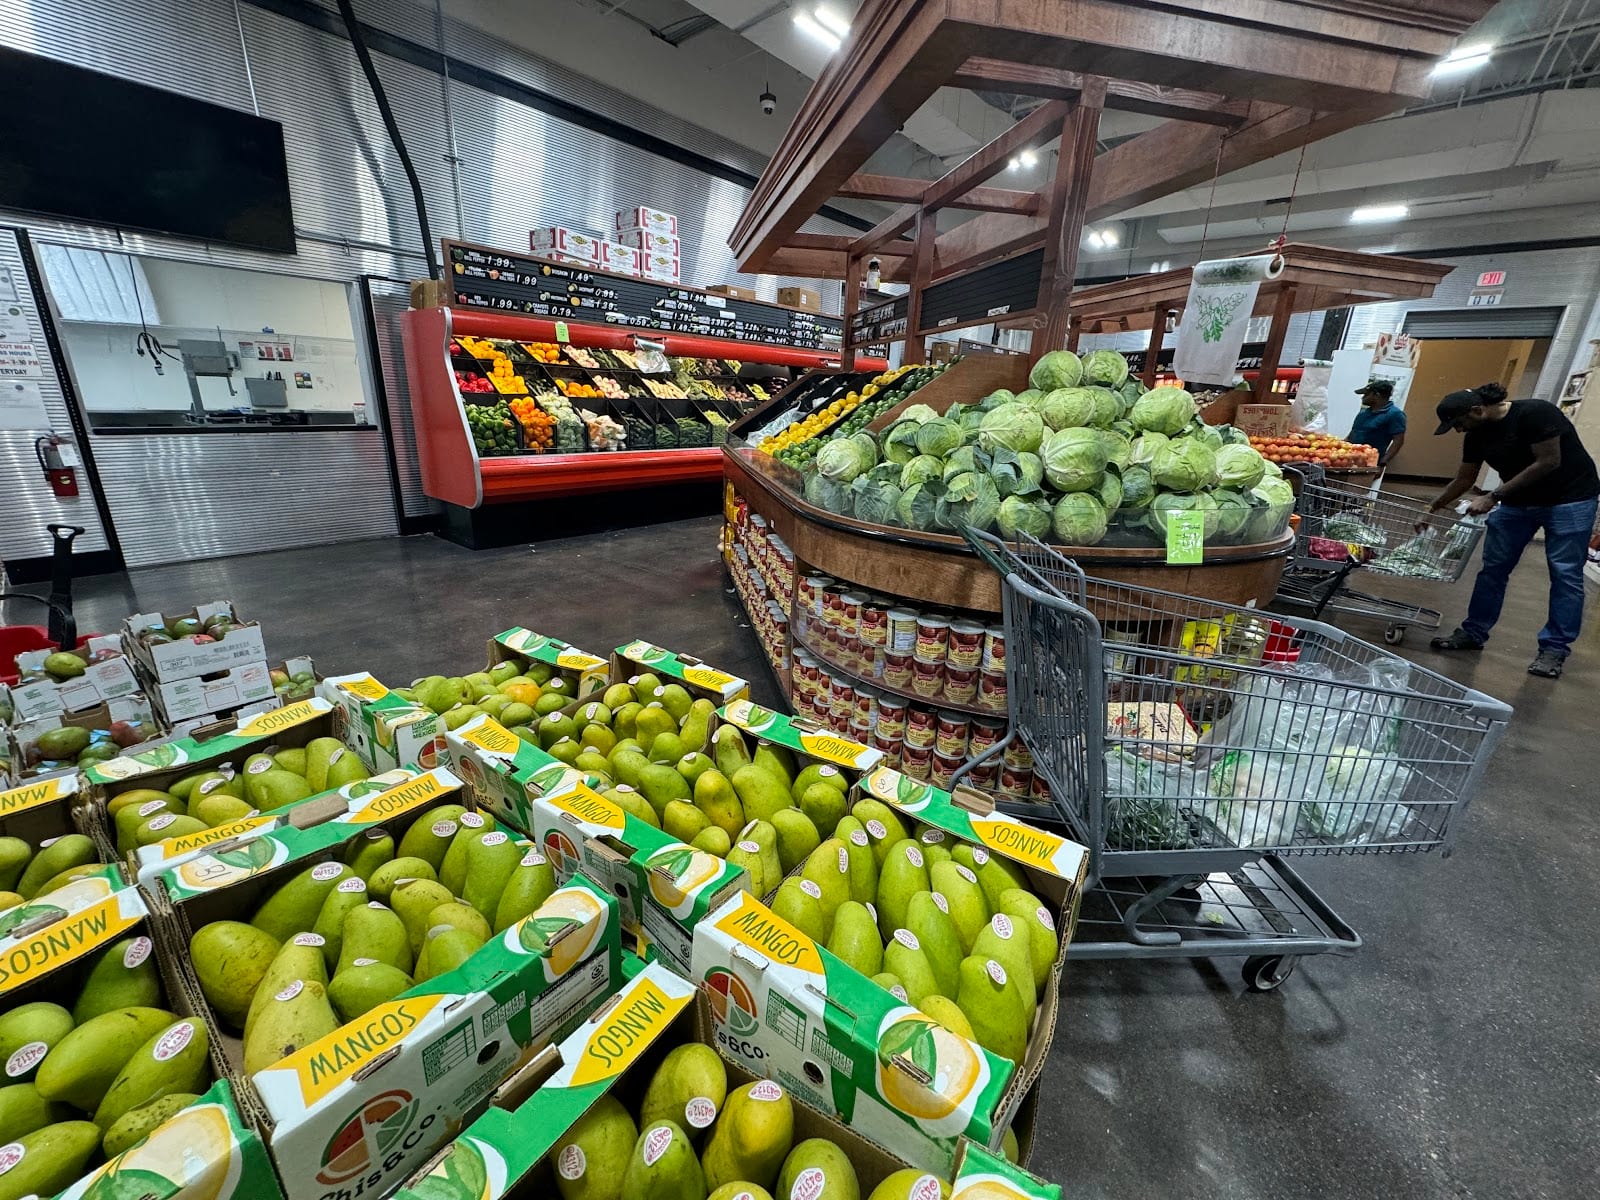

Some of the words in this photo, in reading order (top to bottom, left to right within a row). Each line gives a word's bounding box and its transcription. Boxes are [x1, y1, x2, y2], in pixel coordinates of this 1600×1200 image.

[516, 274, 537, 286] 1.99
[1481, 272, 1503, 284] EXIT
[491, 297, 512, 310] 1.99
[259, 704, 312, 732] MANGOS
[472, 726, 515, 751] MANGOS
[811, 737, 861, 762] MANGOS
[371, 780, 436, 816] MANGOS
[562, 793, 619, 824] MANGOS
[175, 820, 257, 852] MANGOS
[990, 825, 1057, 861] MANGOS
[0, 909, 108, 985] MANGOS
[733, 911, 811, 965] MANGOS
[590, 989, 667, 1070] MANGOS
[309, 1004, 418, 1086] MANGOS
[758, 1086, 775, 1096] 4312
[692, 1106, 709, 1119] 4312
[649, 1131, 667, 1156] 4312
[566, 1153, 577, 1176] 4312
